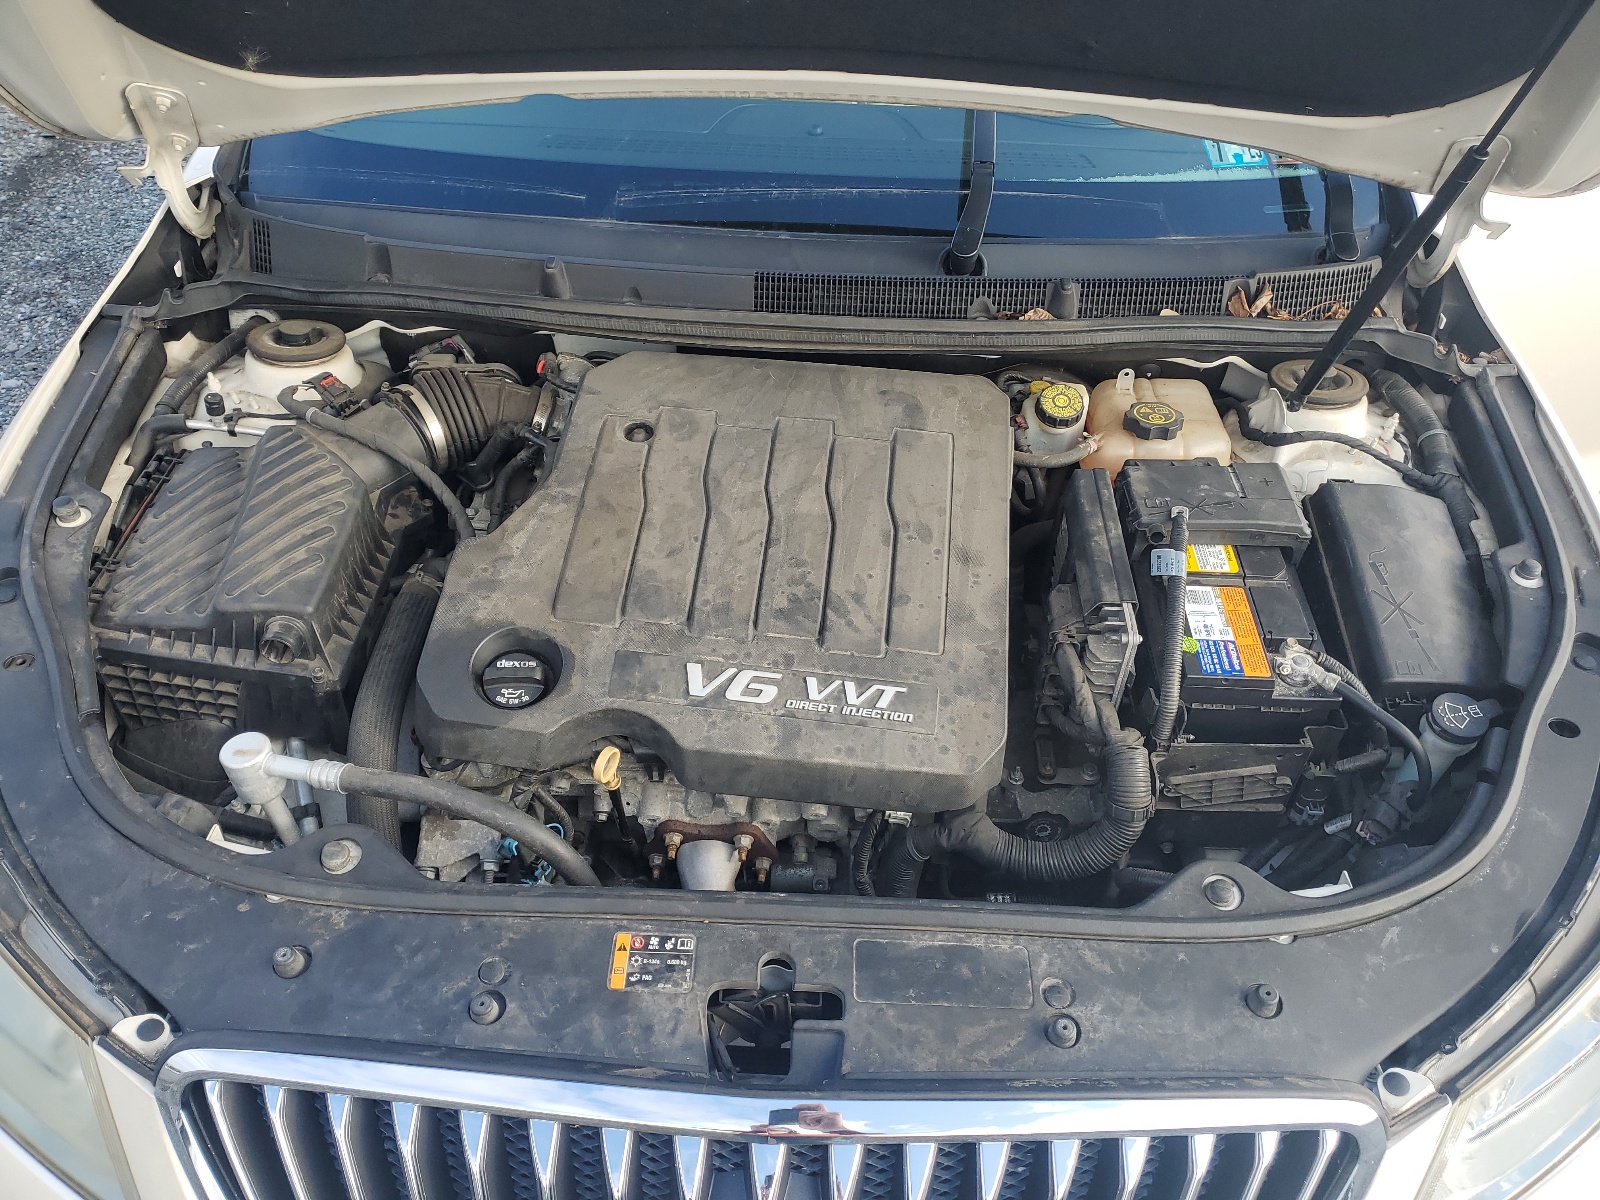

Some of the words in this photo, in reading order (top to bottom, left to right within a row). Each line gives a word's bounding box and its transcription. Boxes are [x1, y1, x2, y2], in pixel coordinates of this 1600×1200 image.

[496, 659, 537, 668] dexos
[686, 662, 783, 704] V6
[805, 676, 908, 710] VVT
[785, 699, 838, 714] DIRECT
[841, 705, 914, 723] INJECTION
